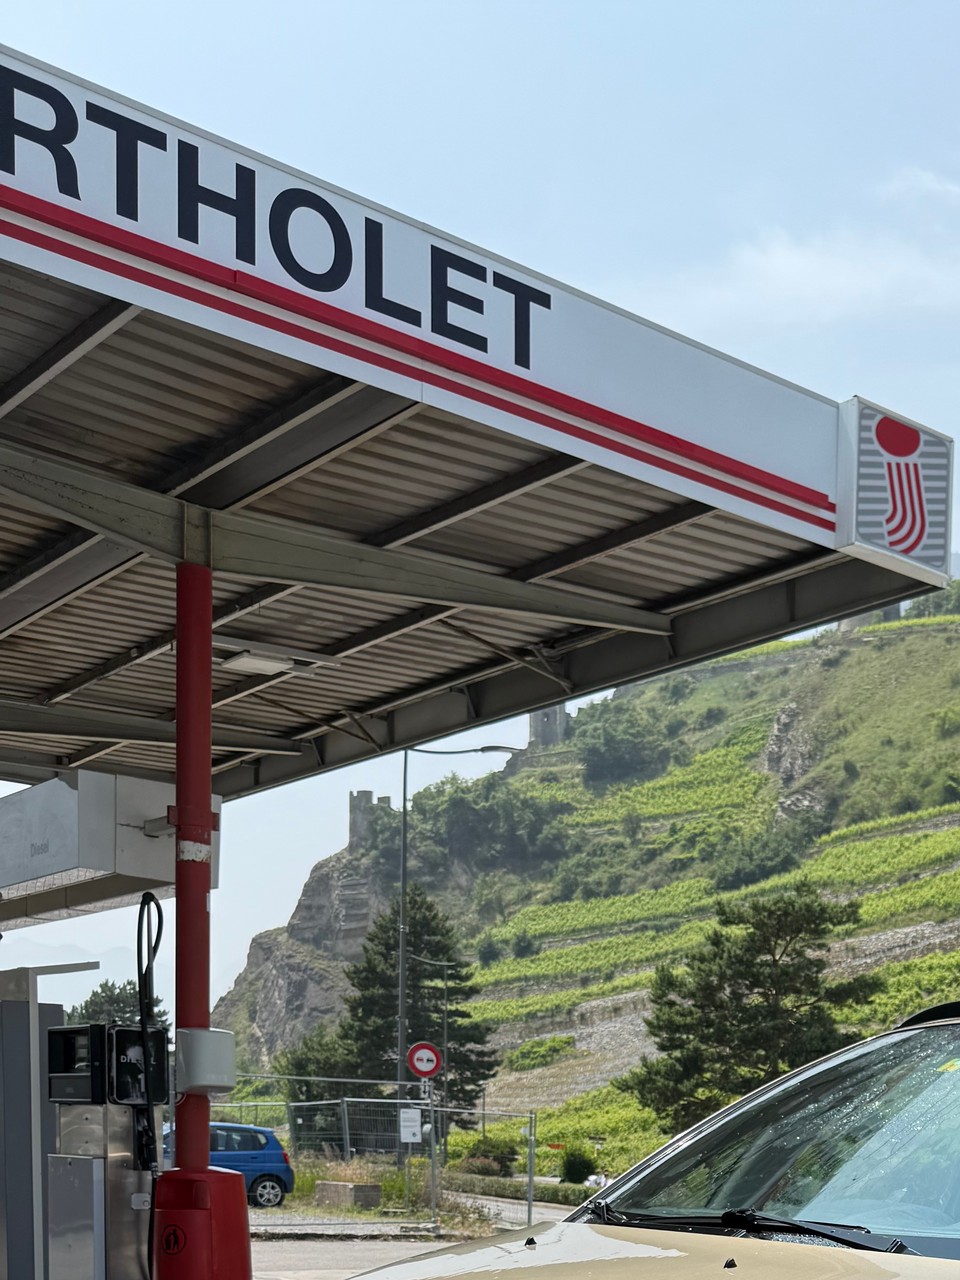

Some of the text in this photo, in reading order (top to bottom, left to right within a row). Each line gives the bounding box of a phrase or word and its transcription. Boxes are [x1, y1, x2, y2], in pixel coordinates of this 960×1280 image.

[0, 64, 552, 371] RTHOLET
[30, 839, 50, 858] Diesel
[120, 1054, 156, 1065] DIESL
